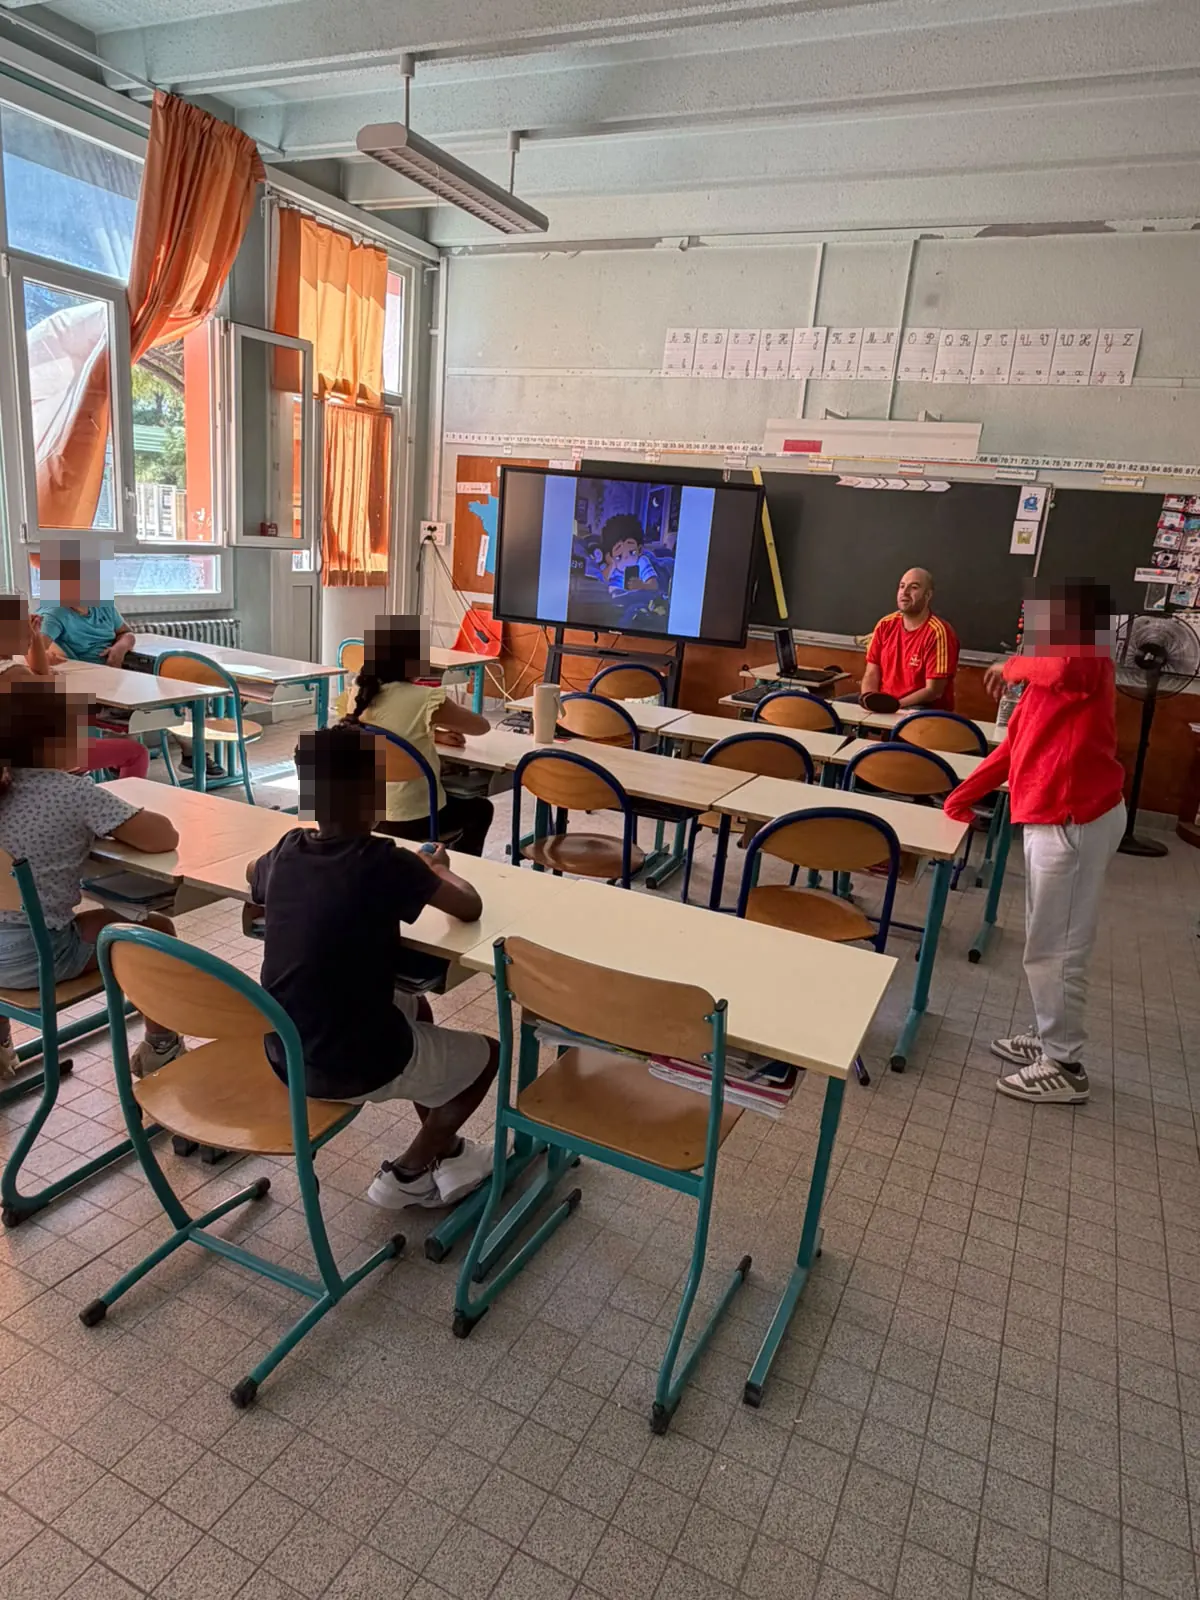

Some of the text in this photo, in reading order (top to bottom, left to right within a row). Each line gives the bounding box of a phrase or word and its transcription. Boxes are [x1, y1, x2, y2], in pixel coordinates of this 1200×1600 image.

[907, 332, 917, 344] O
[944, 334, 954, 346] Q
[1020, 334, 1032, 346] U
[1040, 333, 1049, 346] V
[1060, 333, 1075, 346] W
[1122, 333, 1134, 346] Z
